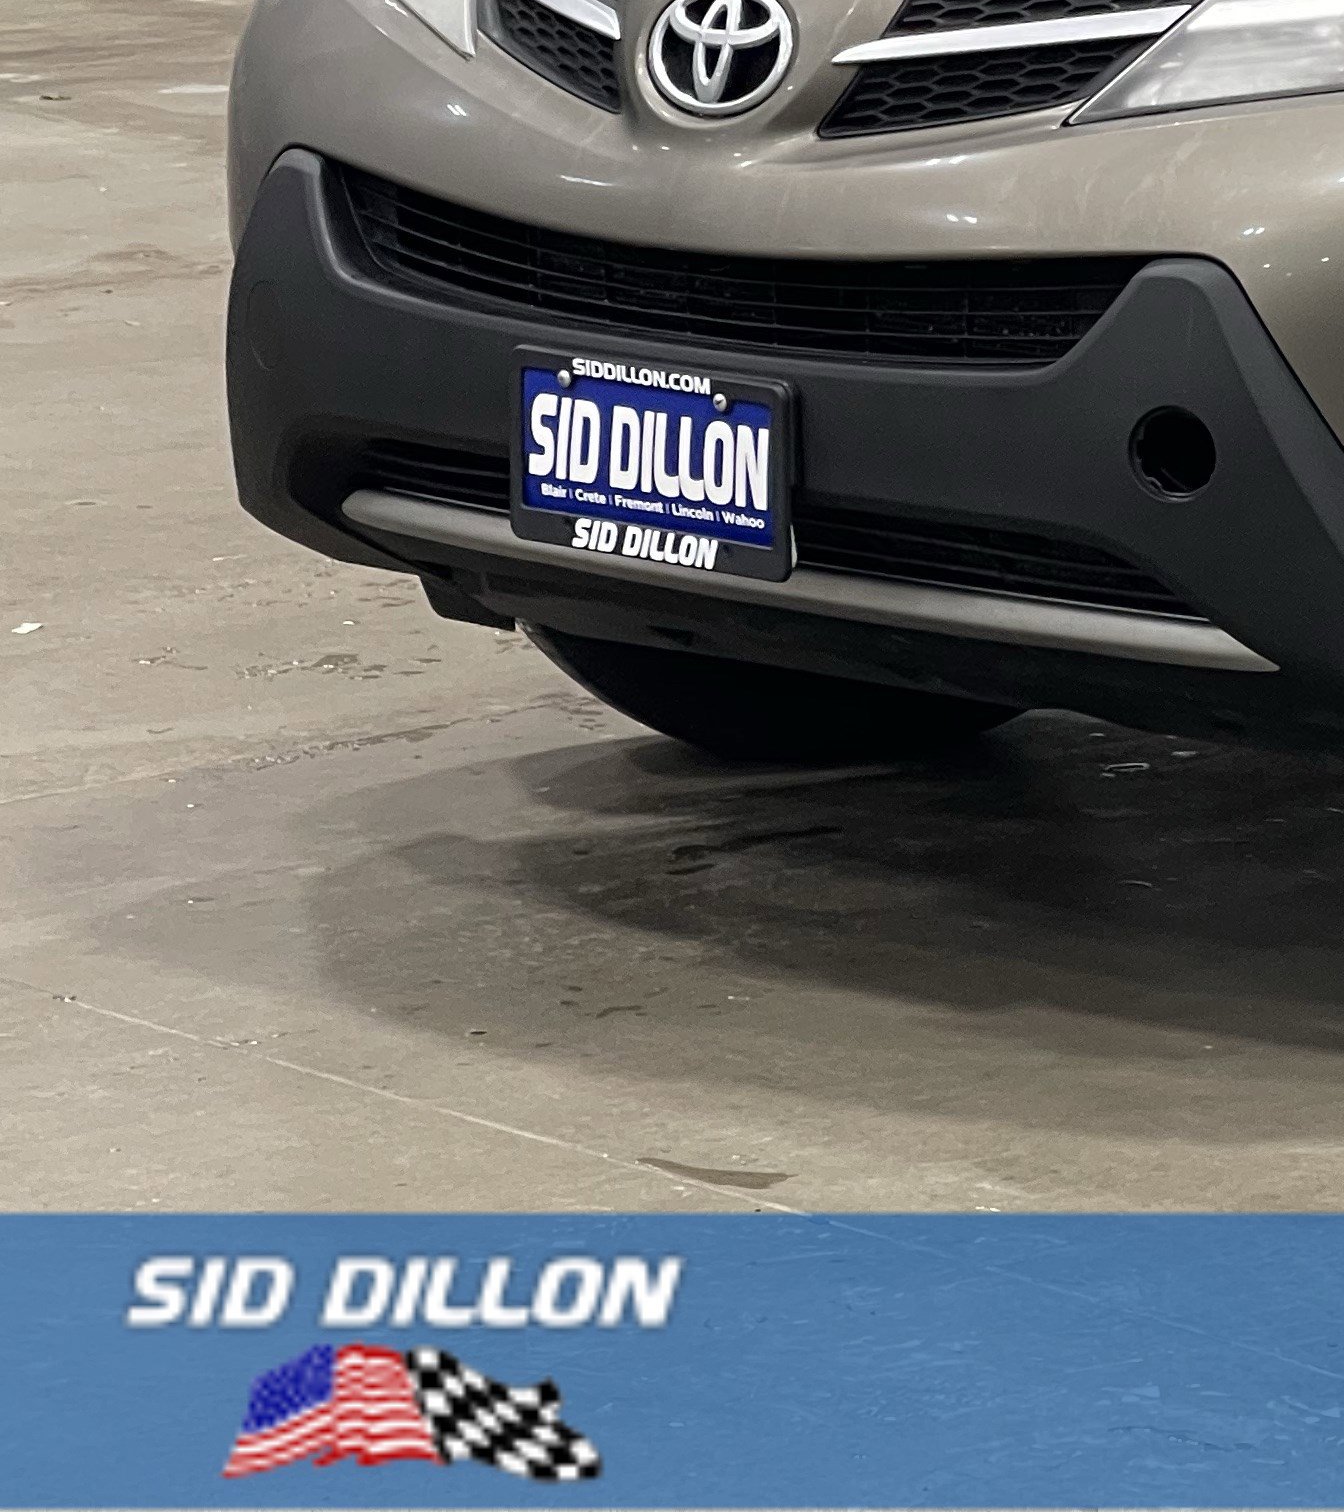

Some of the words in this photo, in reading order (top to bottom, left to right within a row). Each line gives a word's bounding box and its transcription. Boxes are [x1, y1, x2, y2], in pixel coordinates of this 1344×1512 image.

[571, 357, 711, 395] SIDDILLON.COM
[528, 393, 601, 484] SID
[608, 405, 770, 511] DILLON
[541, 483, 567, 498] Blair
[574, 488, 607, 505] Crete
[614, 494, 664, 514] Fremont
[671, 503, 714, 522] Lincoln
[721, 511, 766, 529] Wahoo
[571, 517, 618, 553] SID
[621, 525, 718, 570] DILLON
